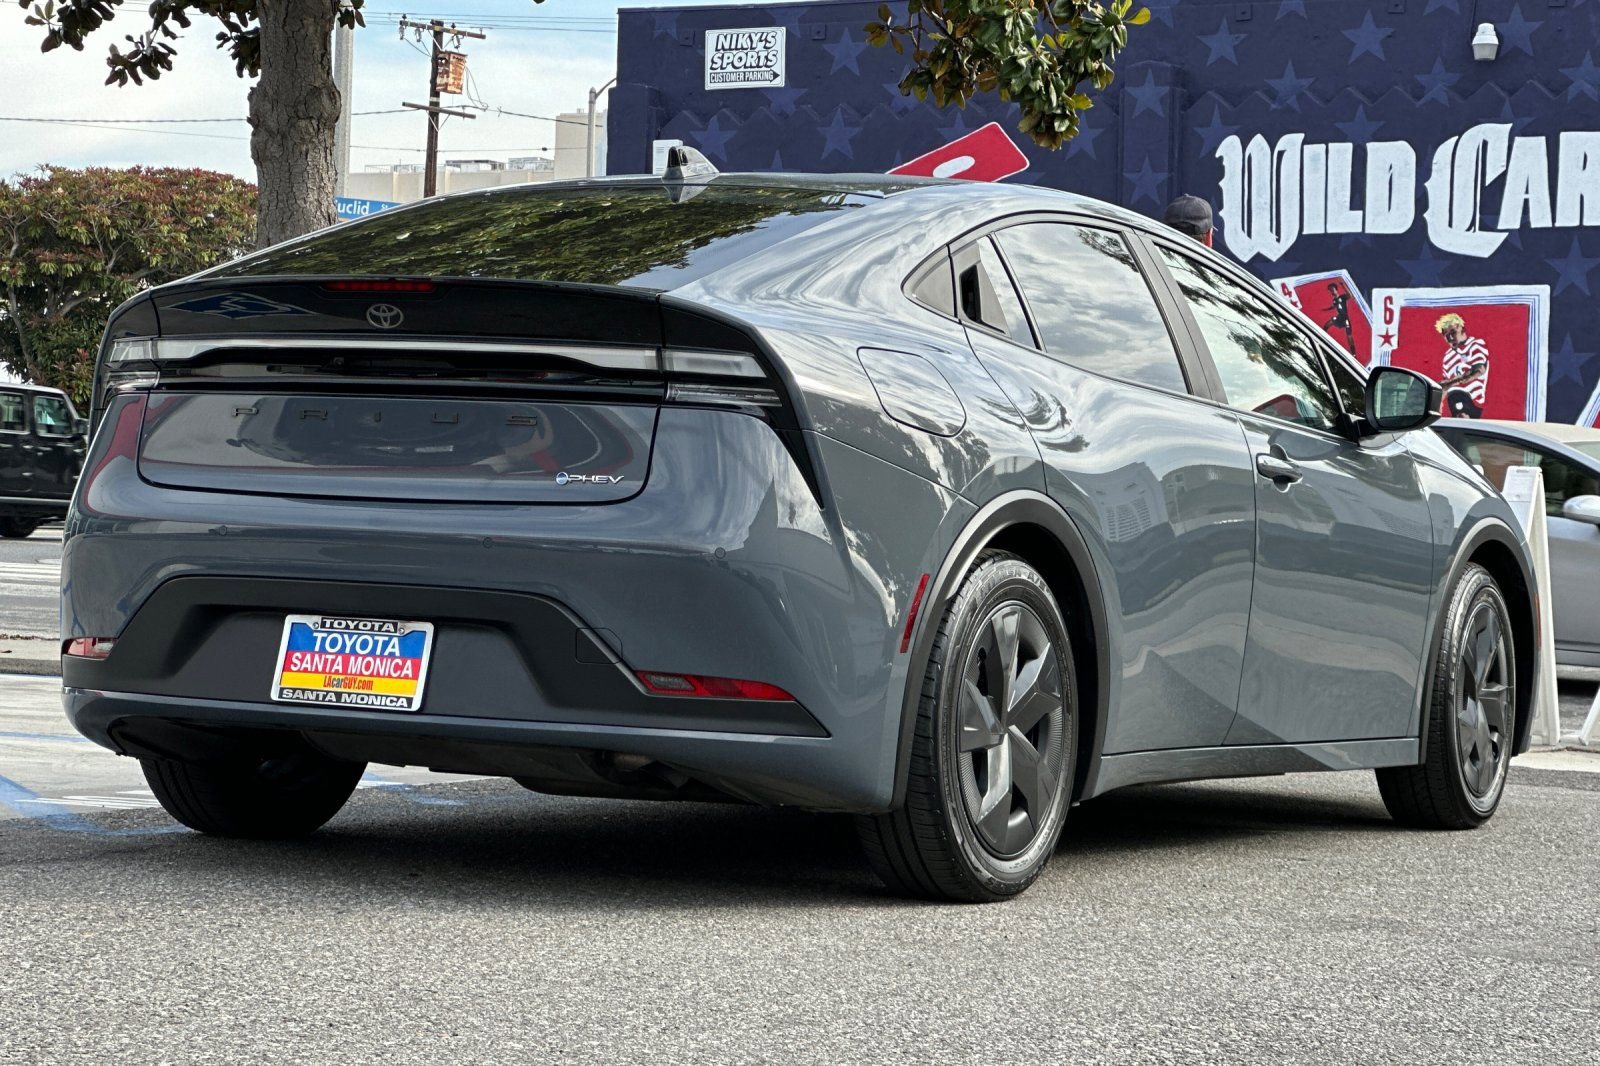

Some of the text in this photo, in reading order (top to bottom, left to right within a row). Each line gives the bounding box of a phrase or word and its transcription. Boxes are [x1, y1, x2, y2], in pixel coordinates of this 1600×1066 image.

[715, 31, 777, 51] NIKY'S
[710, 50, 778, 70] SPORTS
[710, 70, 774, 83] CUSTOMER PARKING
[1215, 132, 1416, 263] WILD
[335, 200, 370, 215] uclid
[1383, 295, 1394, 325] 6
[232, 407, 538, 426] PRIUS
[568, 474, 624, 484] PHEV
[322, 619, 395, 632] TOYOTA
[313, 632, 401, 657] TOYOTA
[290, 652, 413, 678] SANTA MONICA
[282, 689, 408, 707] SANTA MONICA
